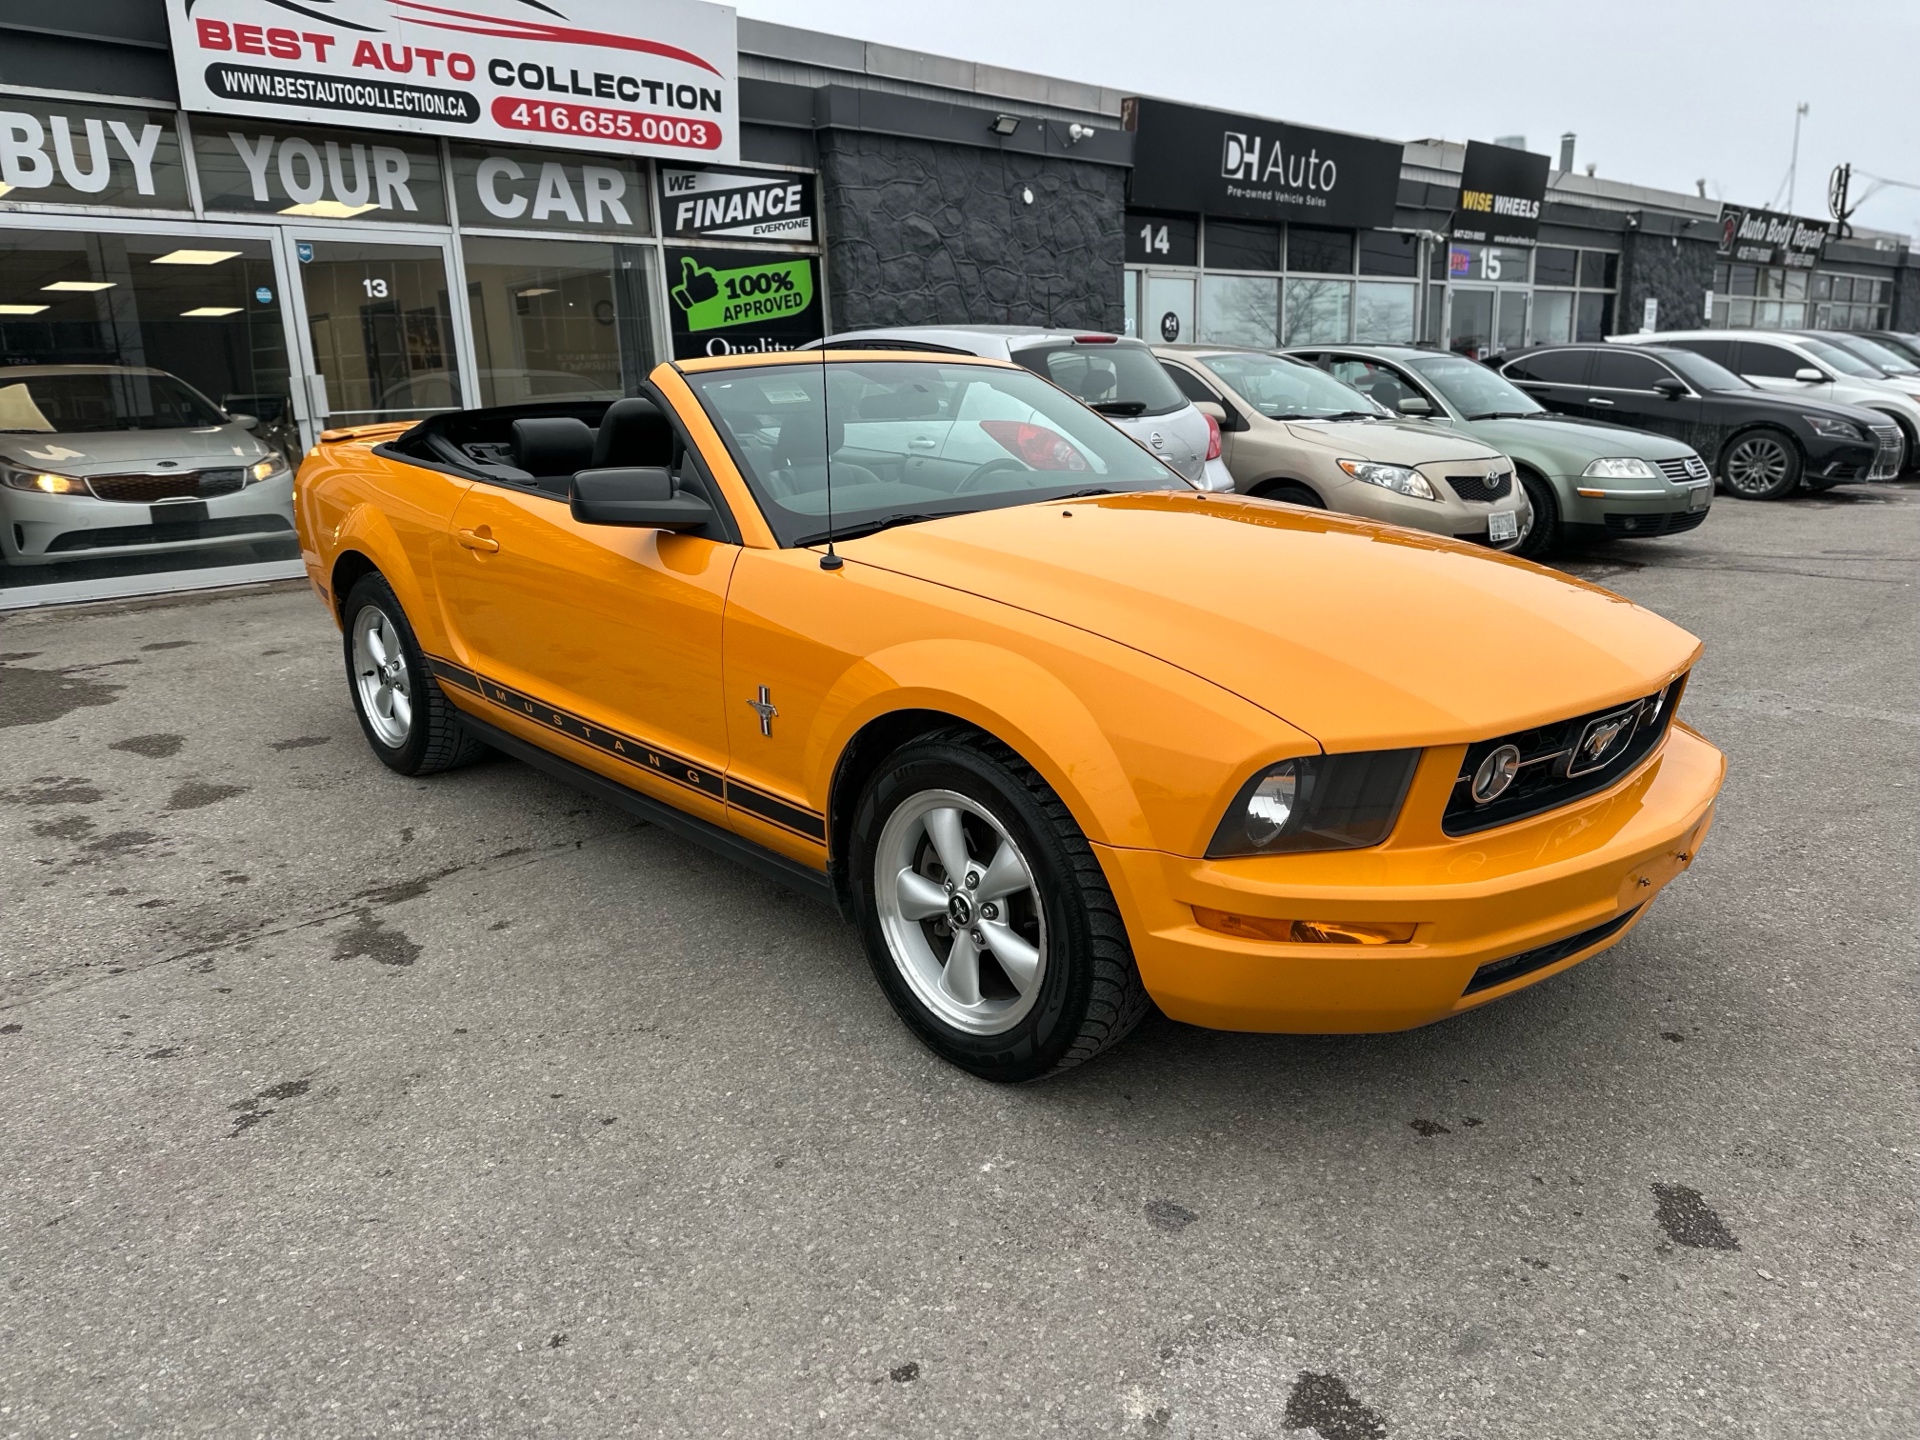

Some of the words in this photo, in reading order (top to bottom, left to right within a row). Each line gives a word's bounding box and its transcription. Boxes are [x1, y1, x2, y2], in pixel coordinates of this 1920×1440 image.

[195, 17, 336, 64] BEST
[352, 39, 476, 82] AUTO
[487, 57, 722, 114] COLLECTION
[221, 70, 468, 118] WWW.BESTAUTOCOLLECTION.CA
[510, 102, 708, 146] 416.655.0003
[0, 111, 163, 196] BUY
[227, 131, 419, 212] YOUR
[475, 156, 634, 226] CAR
[1263, 140, 1337, 192] Auto
[668, 174, 696, 192] WE
[1227, 185, 1273, 201] Pre-owned
[1275, 190, 1304, 205] Vehicle
[1305, 195, 1327, 207] Sales
[675, 184, 803, 231] FINANCE
[1462, 190, 1494, 213] WISE
[1494, 194, 1540, 219] WHEELS
[752, 218, 810, 235] EVERYONE
[1140, 223, 1170, 254] 14
[1737, 212, 1766, 241] Auto
[1764, 217, 1794, 251] Body
[1791, 222, 1826, 253] Repair
[1480, 247, 1501, 280] 15
[362, 278, 389, 298] 13
[724, 270, 795, 300] 100%
[722, 291, 804, 323] APPROVED
[495, 689, 700, 784] MUSTANG
